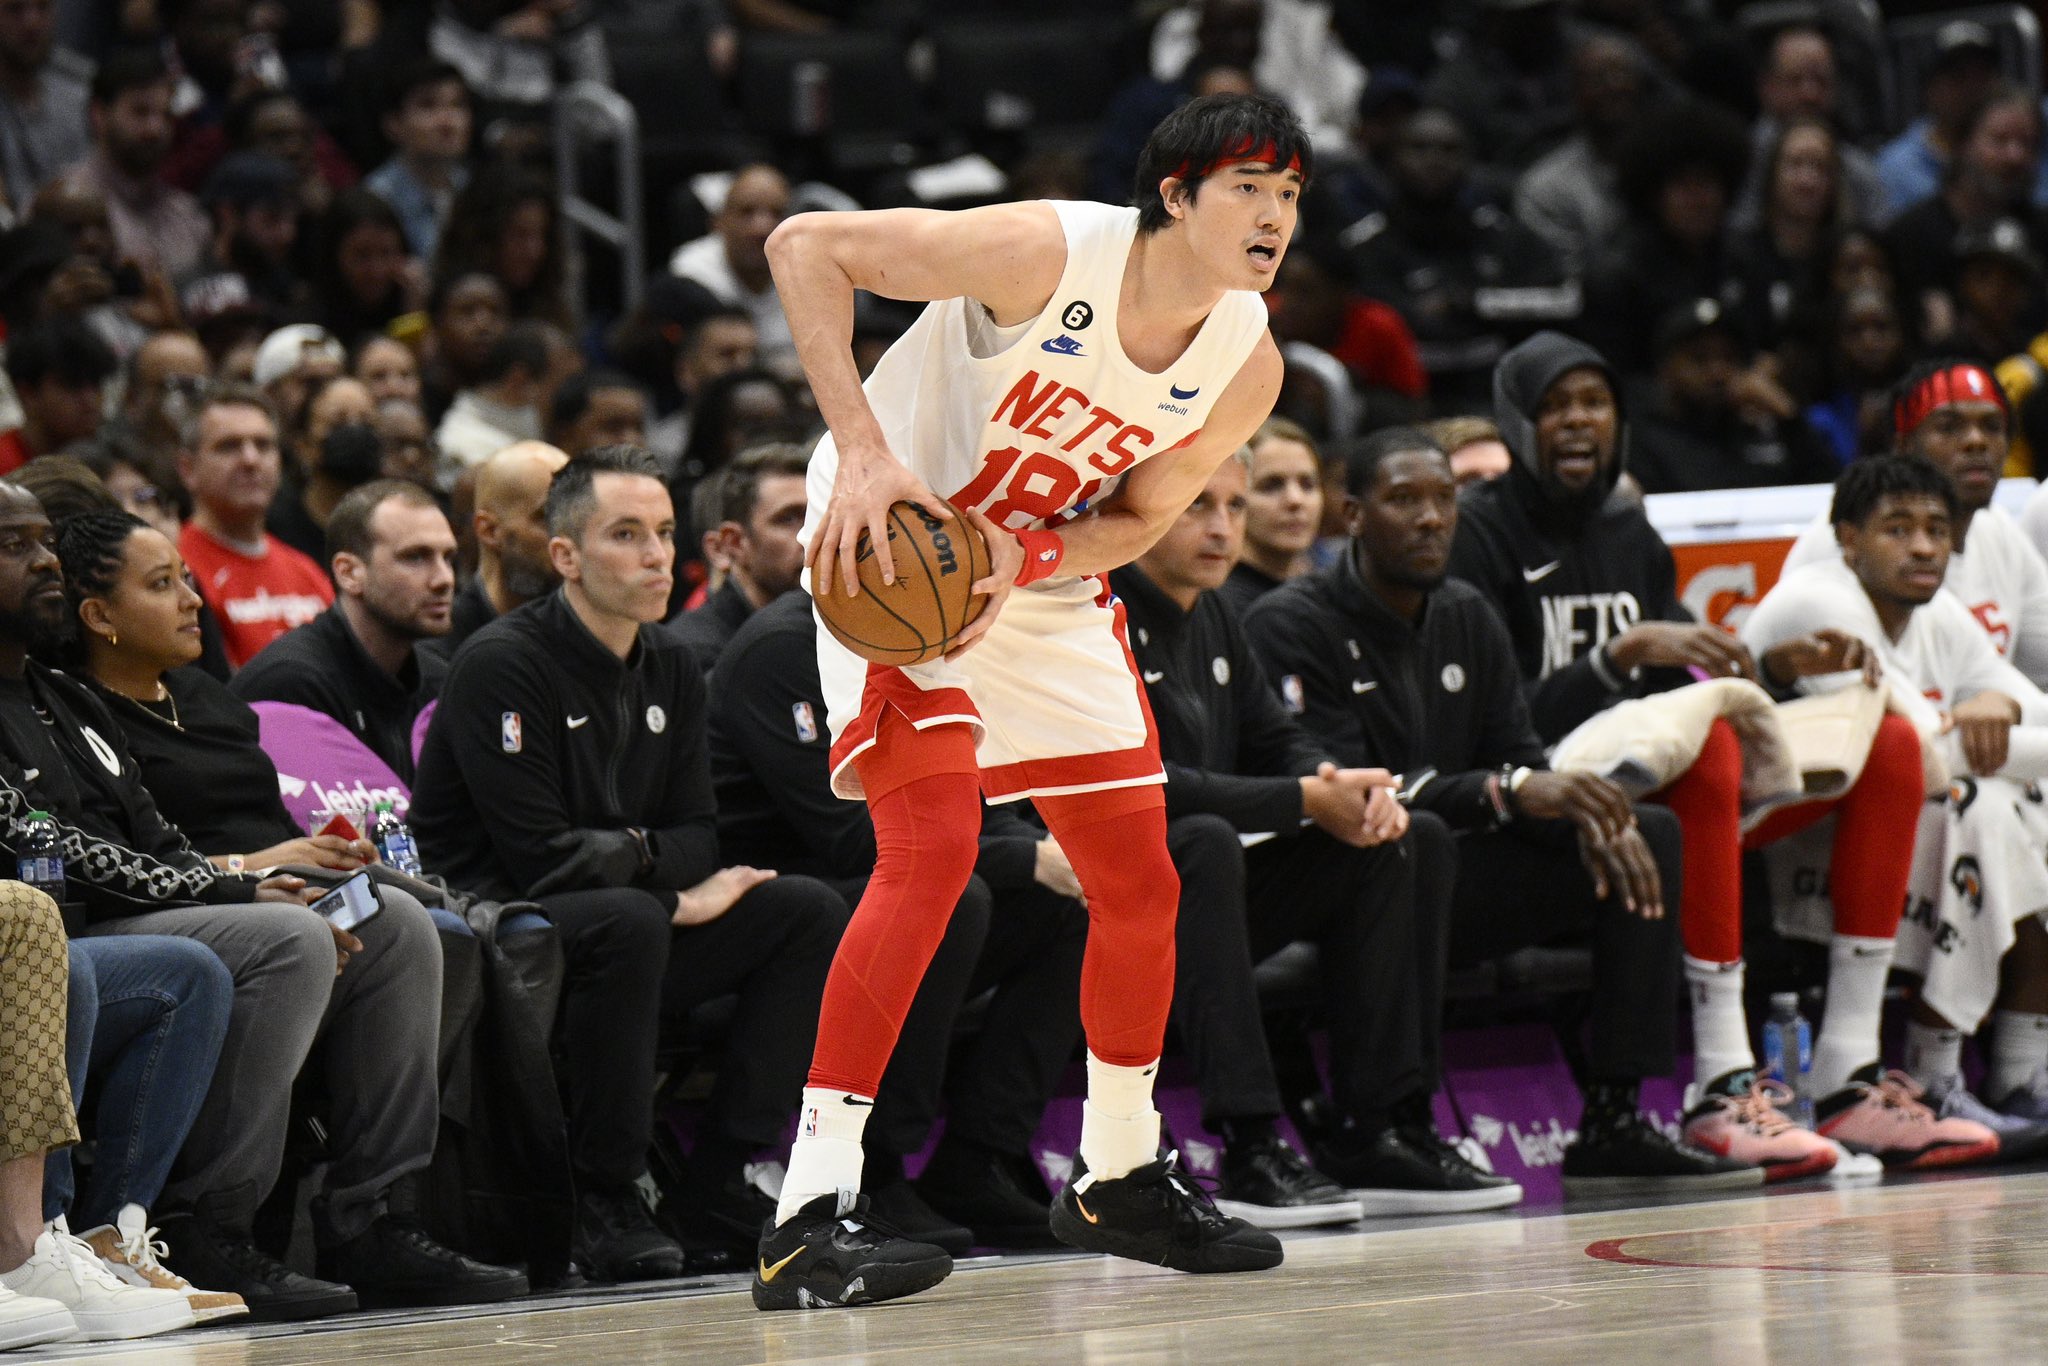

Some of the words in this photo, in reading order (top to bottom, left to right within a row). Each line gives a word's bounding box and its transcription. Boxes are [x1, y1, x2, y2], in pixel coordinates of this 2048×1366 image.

[1065, 304, 1089, 328] 6
[990, 369, 1156, 476] NETS
[1157, 402, 1188, 416] webull
[946, 445, 1082, 533] 18
